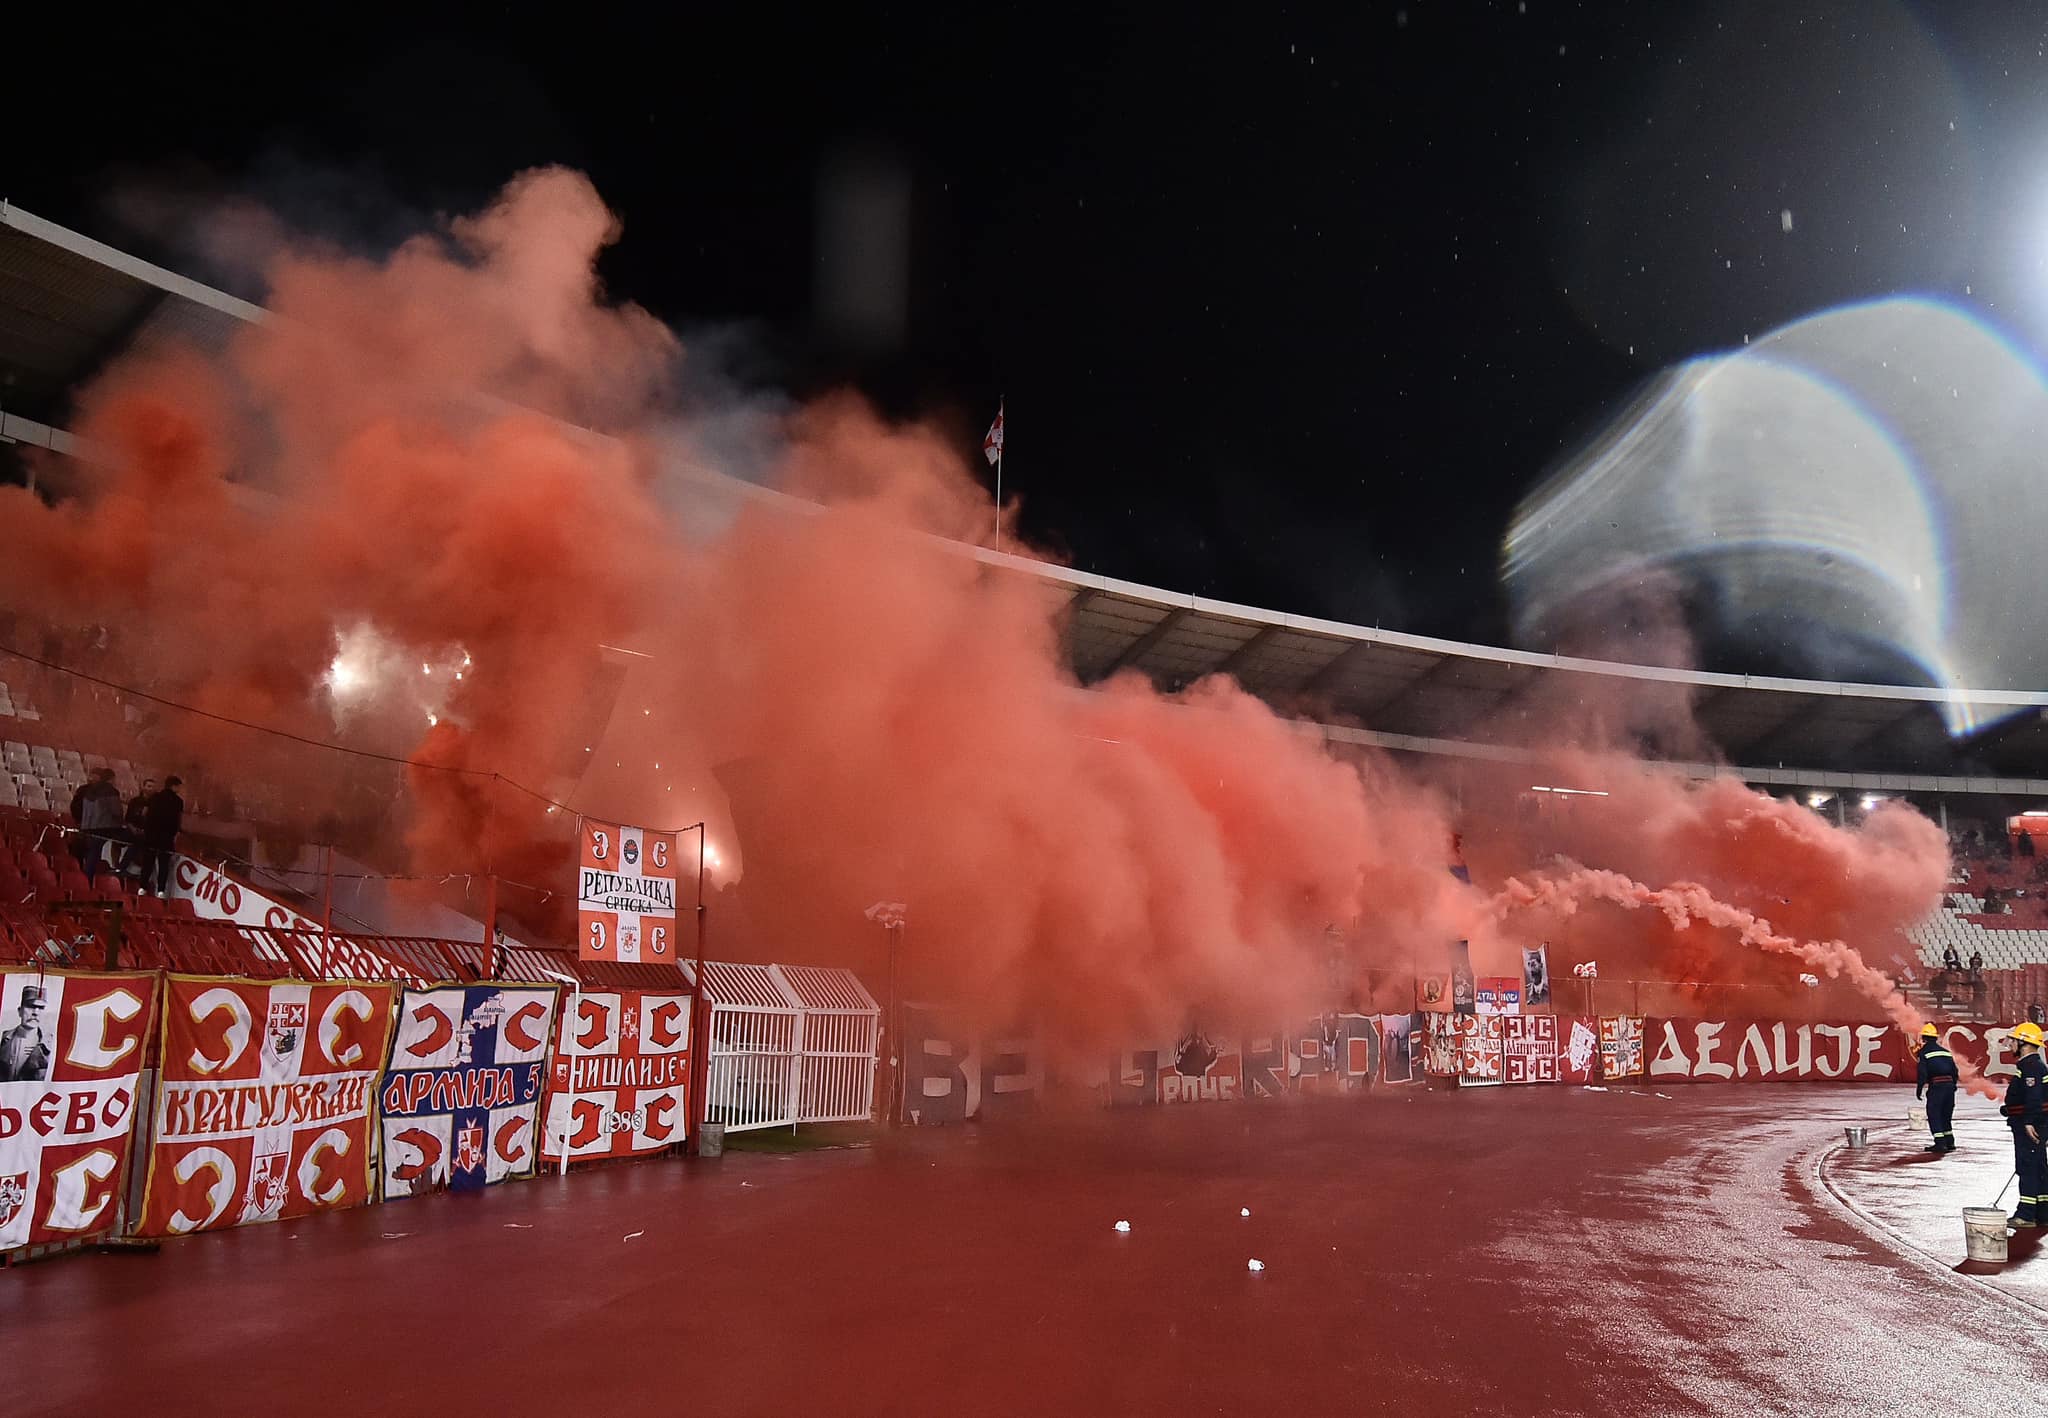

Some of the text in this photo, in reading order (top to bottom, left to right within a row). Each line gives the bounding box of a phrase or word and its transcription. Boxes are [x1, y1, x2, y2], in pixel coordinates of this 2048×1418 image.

[583, 870, 675, 910] РЕПУБЛИКА
[605, 895, 653, 913] СРПСКА
[1650, 1021, 1893, 1079] ДЕЛИЈЕ
[384, 1063, 541, 1115] АРМИЈА 5
[572, 1056, 678, 1089] НИШЛИЈЕ
[162, 1076, 368, 1137] КРАГУЈЕВАЦ
[604, 1109, 643, 1134] 1986
